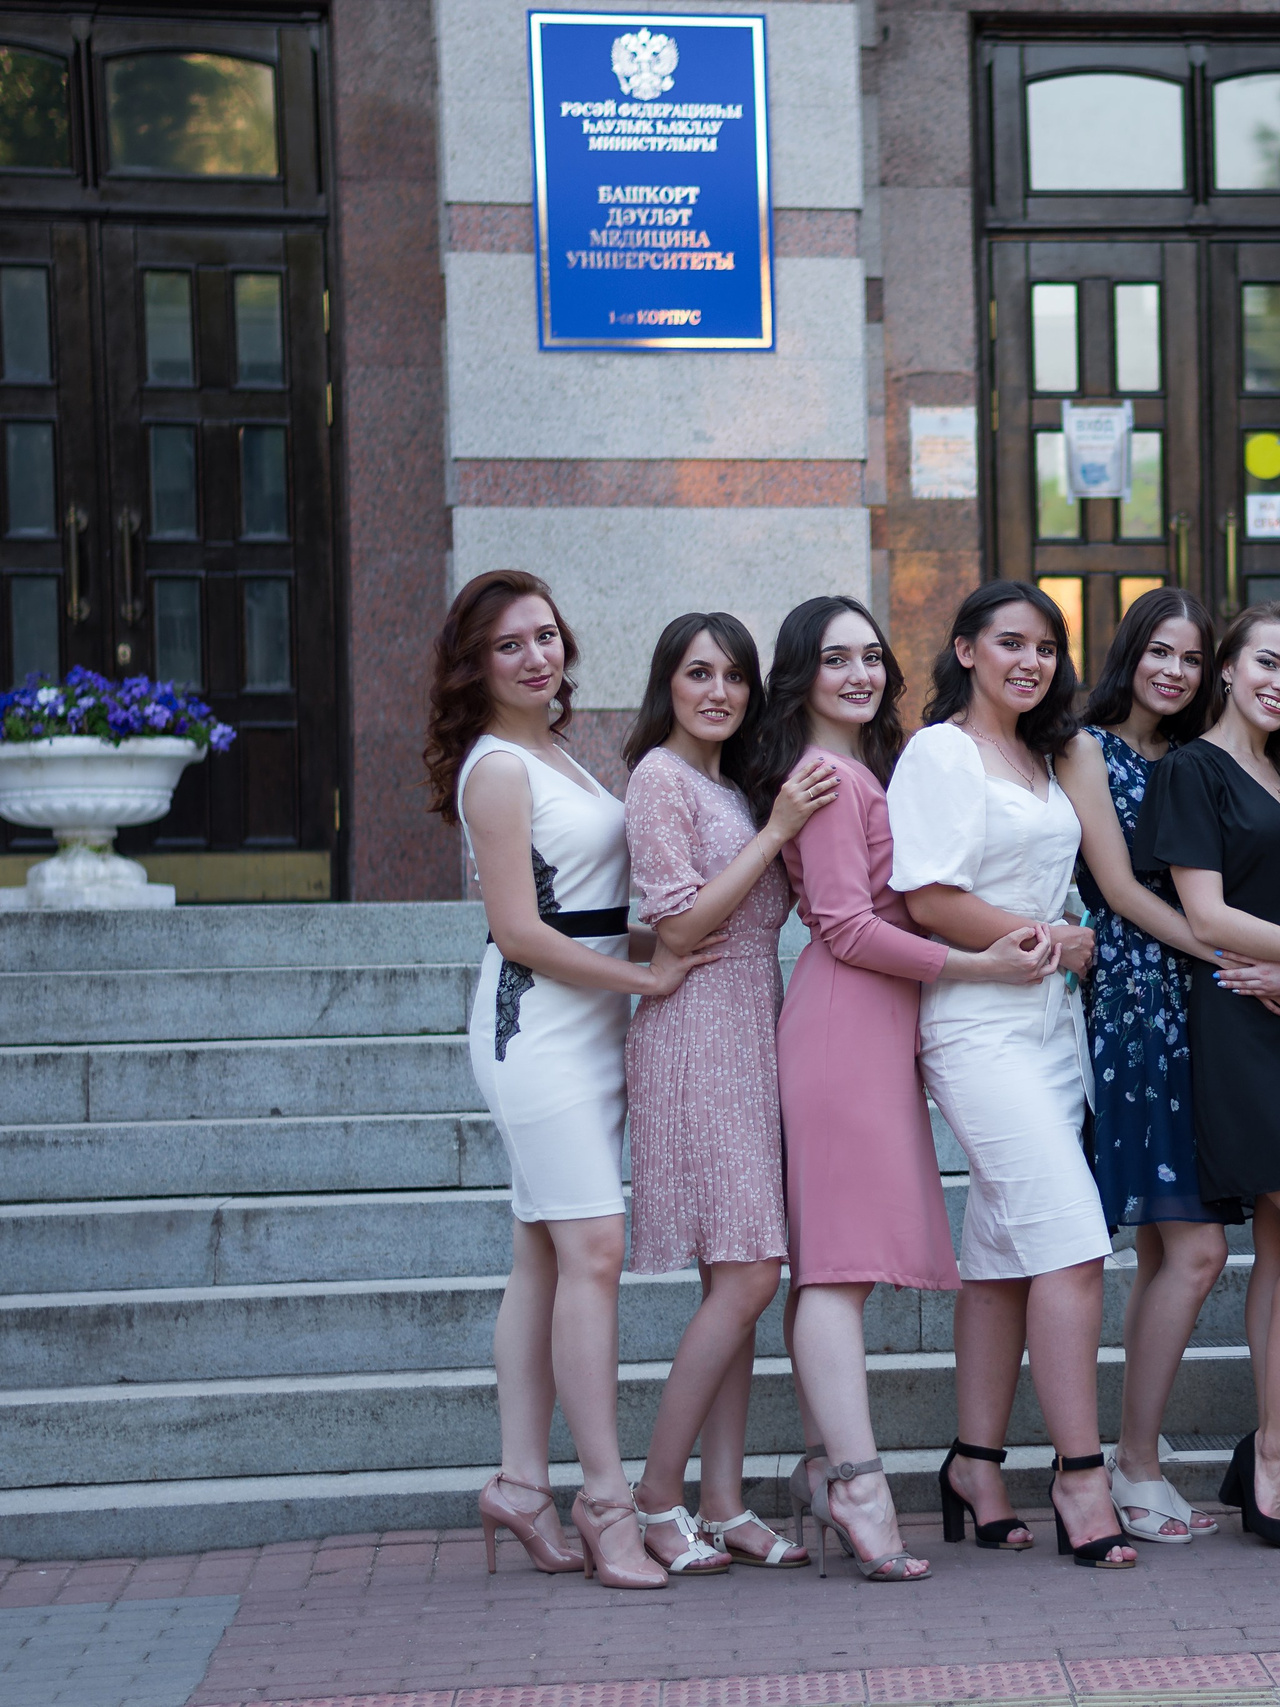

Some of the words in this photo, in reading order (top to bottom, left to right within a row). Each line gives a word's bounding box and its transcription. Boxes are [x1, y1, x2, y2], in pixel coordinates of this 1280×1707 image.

[589, 229, 711, 250] МЕДИЦИНА
[566, 251, 735, 271] УНИВЕРСИТЕТЫ
[637, 309, 701, 326] КОРПУС
